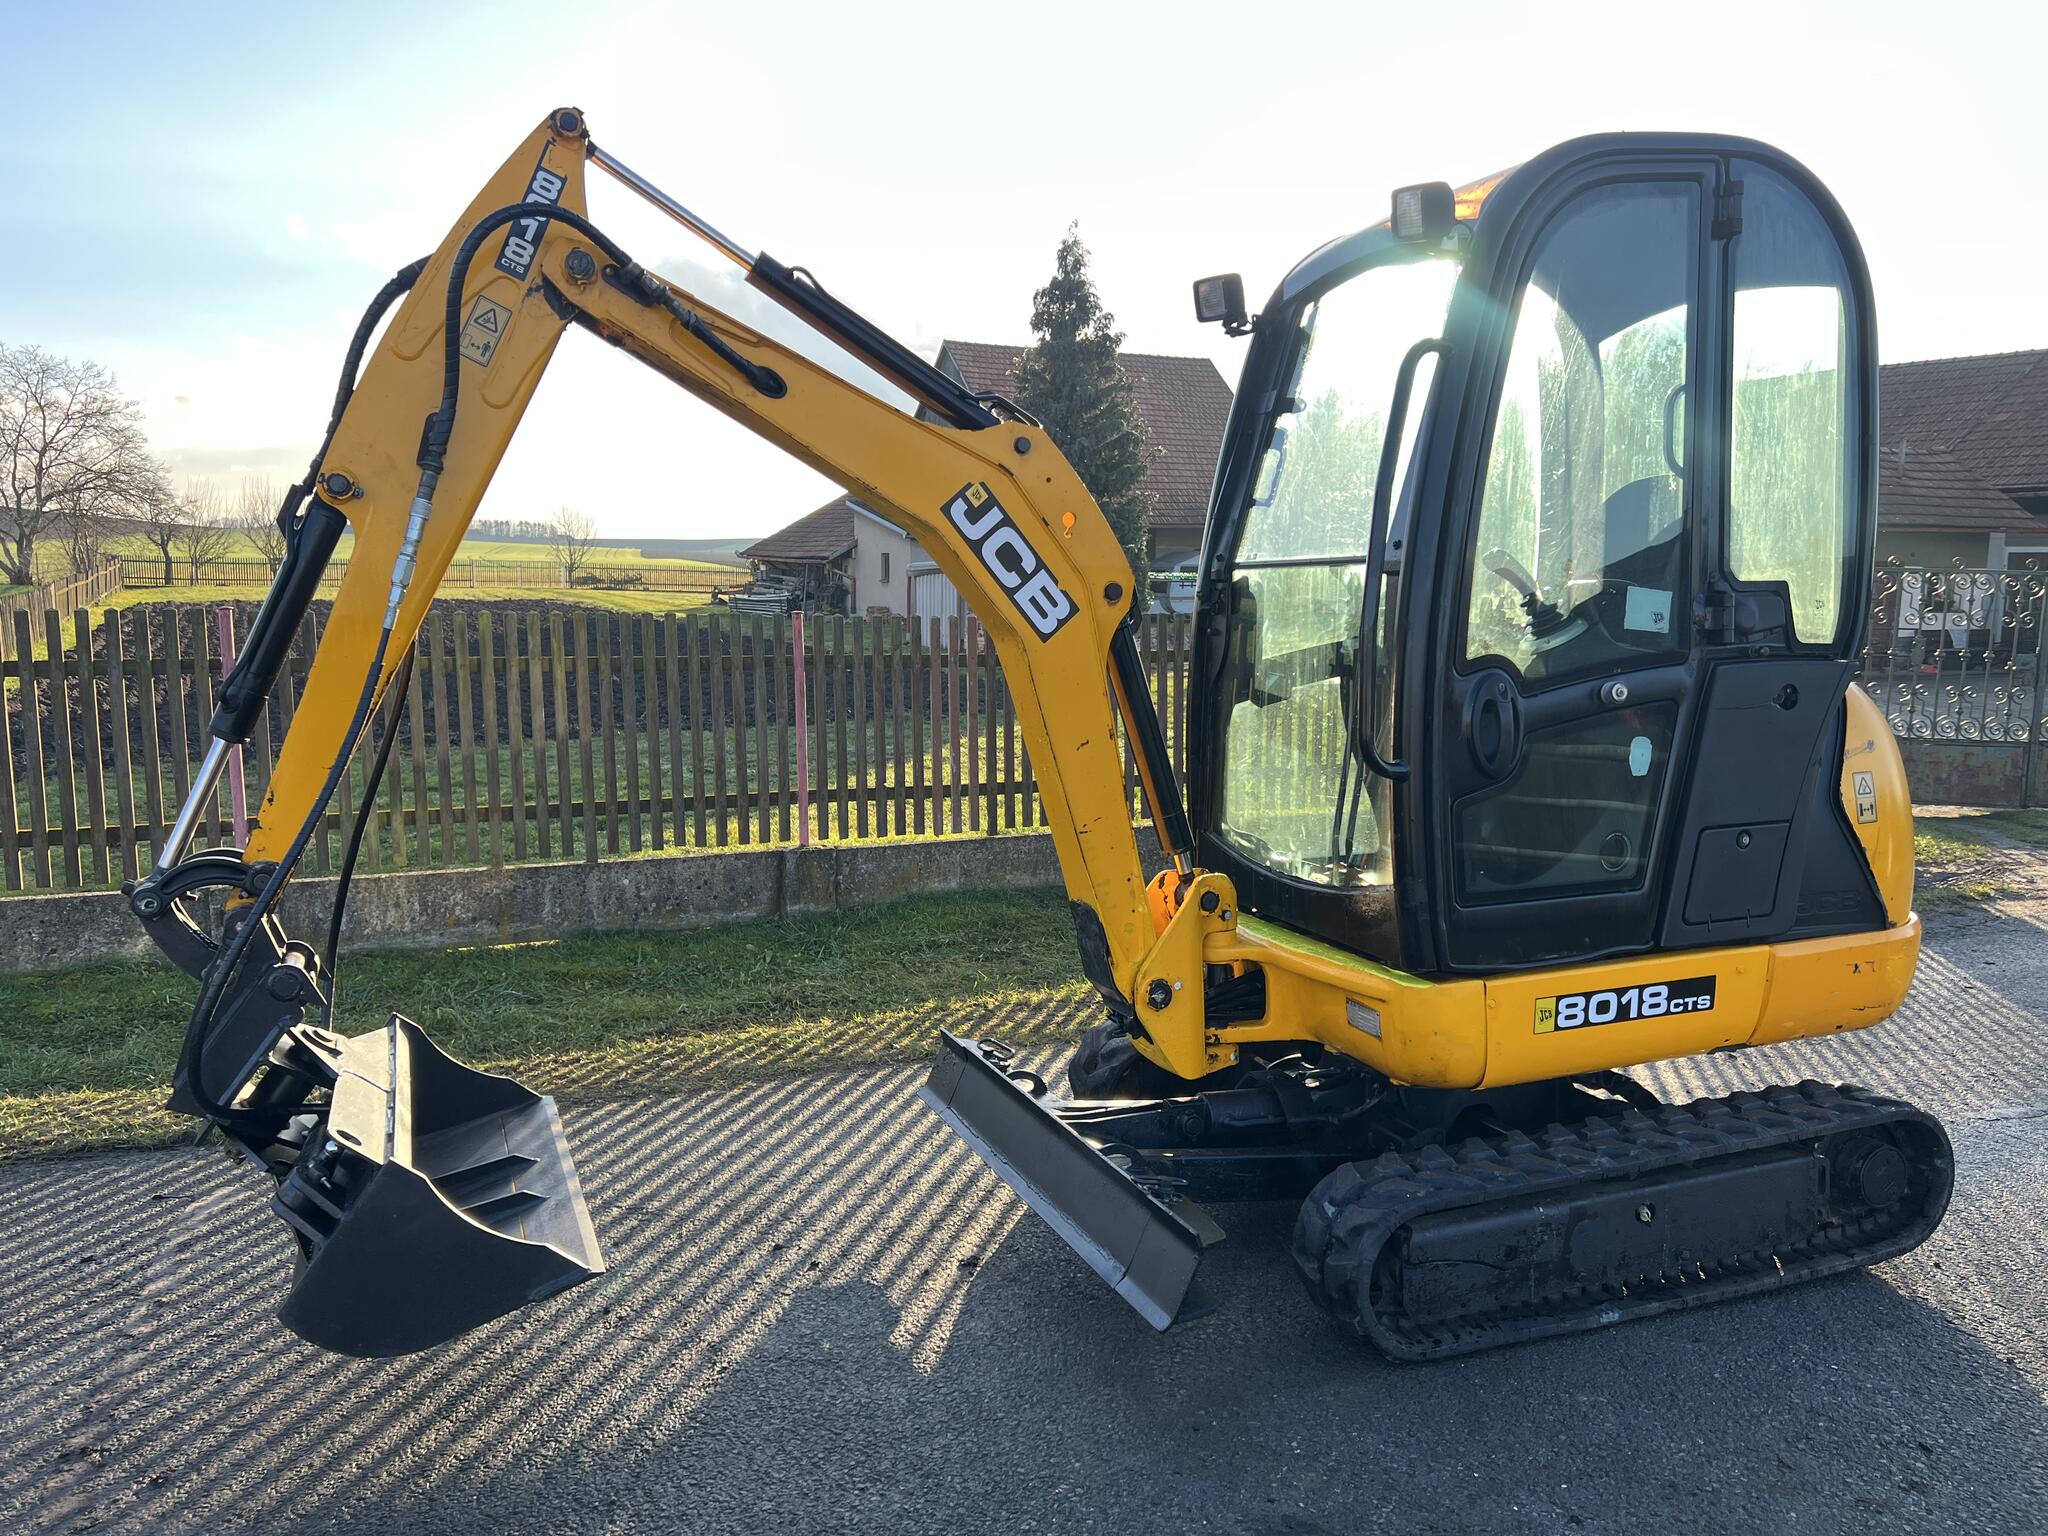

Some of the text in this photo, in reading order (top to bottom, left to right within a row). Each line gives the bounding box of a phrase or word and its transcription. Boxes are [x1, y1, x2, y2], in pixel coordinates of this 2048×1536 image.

[501, 258, 524, 274] CTS
[950, 497, 1071, 634] JCB
[1539, 985, 1711, 1027] JCB 8018 CTS
